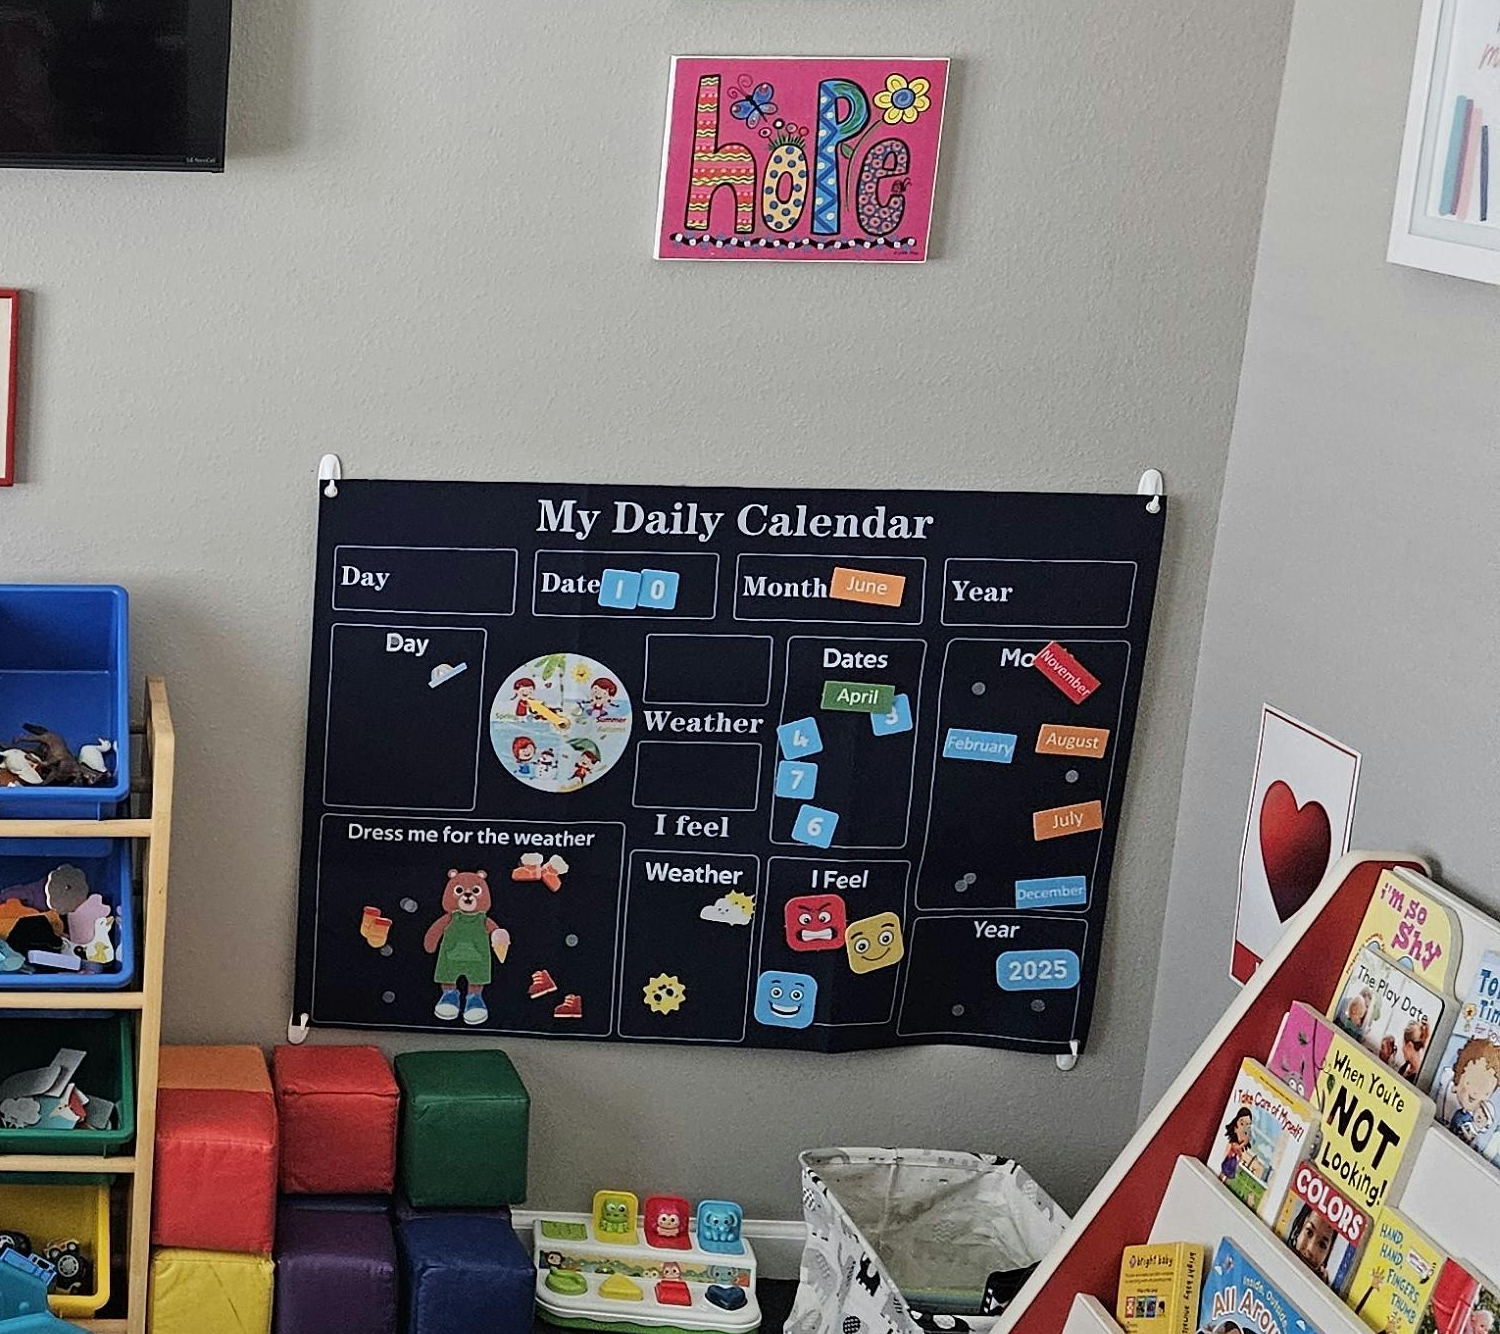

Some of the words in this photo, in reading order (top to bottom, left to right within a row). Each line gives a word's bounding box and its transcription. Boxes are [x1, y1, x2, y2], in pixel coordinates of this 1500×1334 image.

[536, 499, 601, 540] My
[612, 501, 725, 542] Daily
[737, 504, 934, 540] Calendar
[340, 566, 390, 591] Day
[541, 572, 600, 594] Date
[742, 576, 828, 599] Month
[846, 577, 887, 595] June
[952, 581, 1013, 603] Year
[386, 633, 429, 656] Day
[823, 648, 888, 669] Dates
[1041, 648, 1091, 697] November
[836, 688, 878, 706] April
[644, 710, 764, 735] Weather
[792, 730, 810, 748] 4
[948, 736, 1014, 756] February
[1045, 733, 1099, 751] August
[790, 769, 805, 790] 7
[654, 814, 667, 835] I
[675, 815, 730, 838] feel
[807, 817, 824, 836] 6
[1052, 811, 1084, 830] July
[348, 824, 403, 841] Dress
[408, 830, 438, 842] me
[442, 826, 472, 843] for
[477, 827, 509, 845] the
[514, 830, 595, 846] weather
[646, 862, 743, 885] Weather
[811, 870, 818, 888] I
[824, 870, 869, 889] Feel
[1017, 884, 1084, 900] December
[973, 920, 1020, 939] Year
[1008, 961, 1068, 981] 2025
[1358, 964, 1376, 988] The
[1376, 979, 1401, 1008] Play
[1401, 996, 1428, 1026] Date
[1334, 1050, 1365, 1089] When
[1368, 1073, 1405, 1113] You're
[1326, 1085, 1400, 1171] NOT
[1321, 1141, 1388, 1207] Looking!
[1296, 1168, 1363, 1241] COLORS
[1136, 1255, 1156, 1268] bright
[1158, 1254, 1173, 1267] baby
[1212, 1285, 1237, 1321] All
[1391, 1293, 1417, 1324] THUMB
